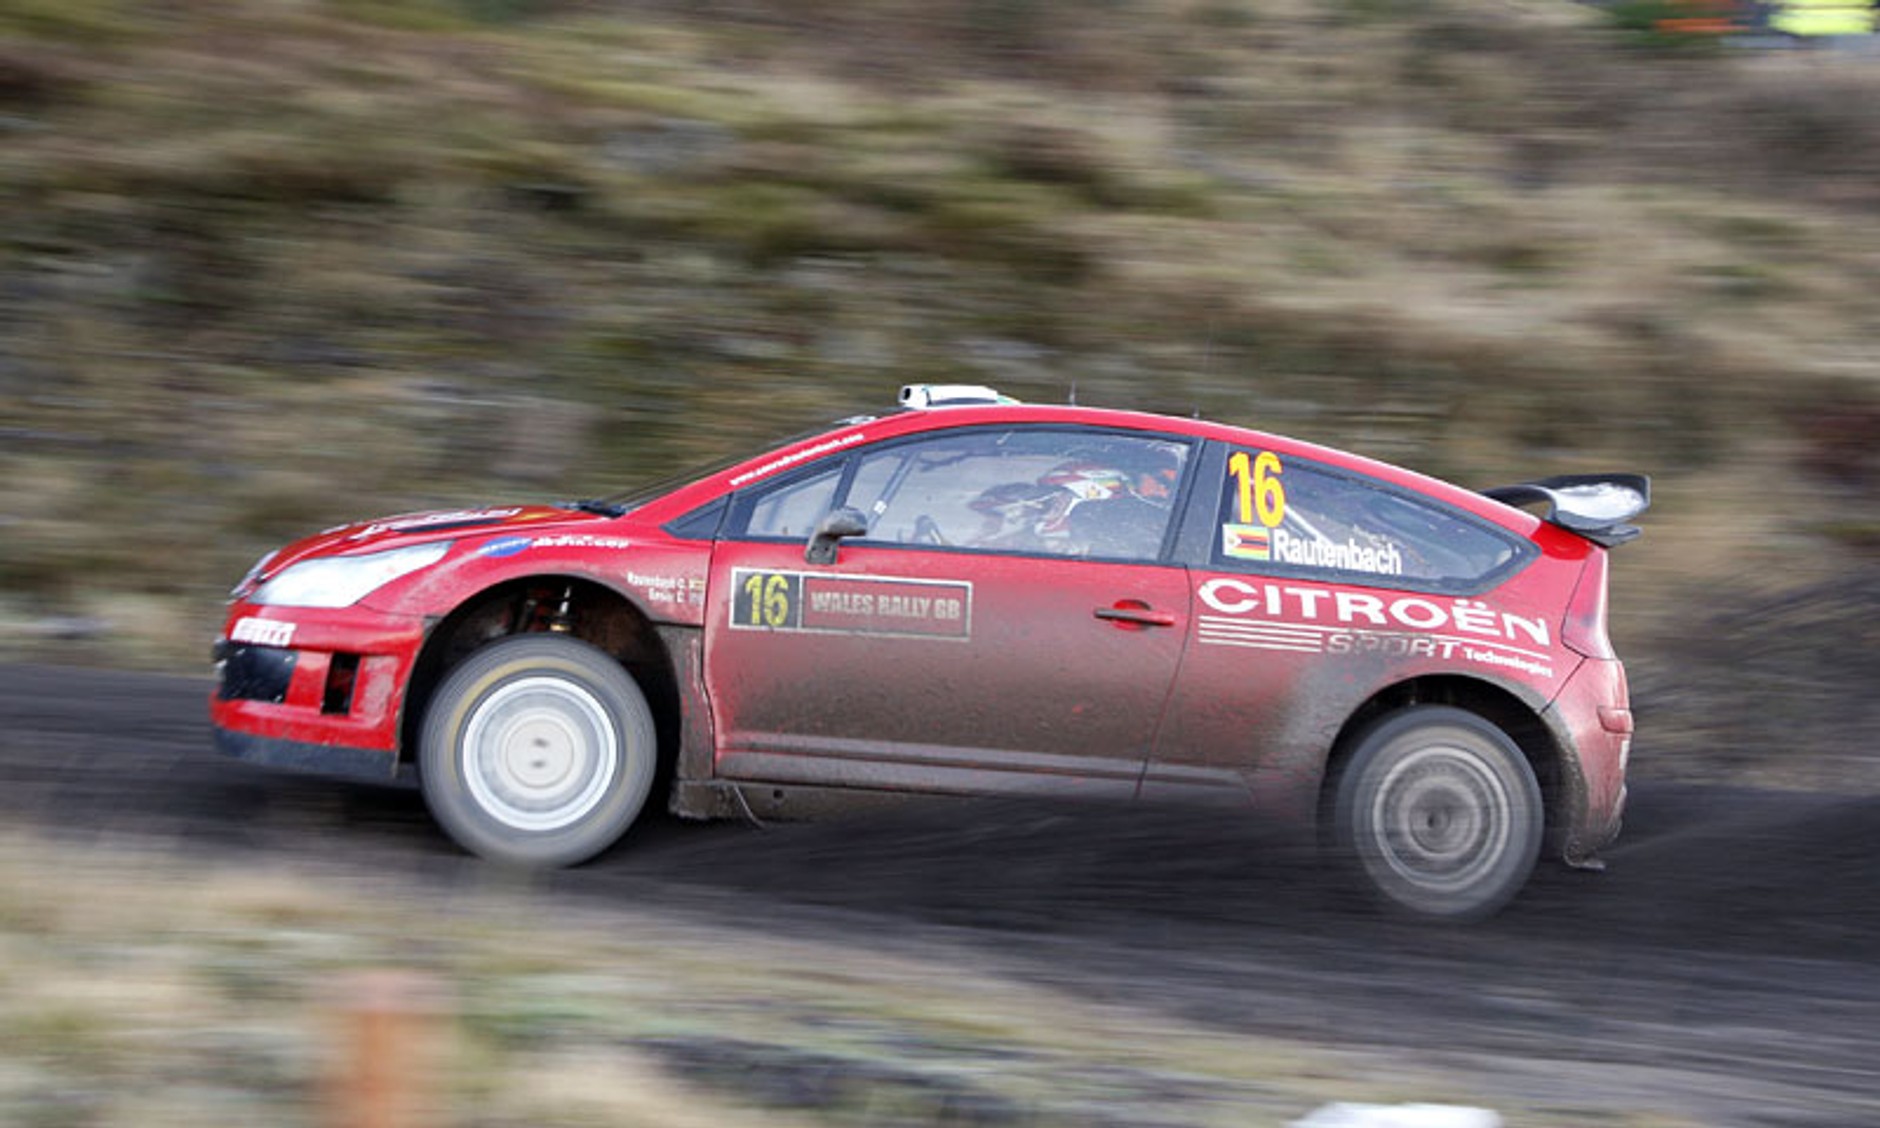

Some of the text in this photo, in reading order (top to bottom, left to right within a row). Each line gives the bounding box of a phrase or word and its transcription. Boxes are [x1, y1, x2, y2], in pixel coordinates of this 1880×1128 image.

[1229, 451, 1285, 528] 16
[1273, 528, 1402, 575] Rautenbach
[745, 573, 788, 627] 16
[811, 591, 960, 619] WALES RALLY GB
[1198, 578, 1550, 647] CITROËN
[1326, 632, 1463, 660] SPORT
